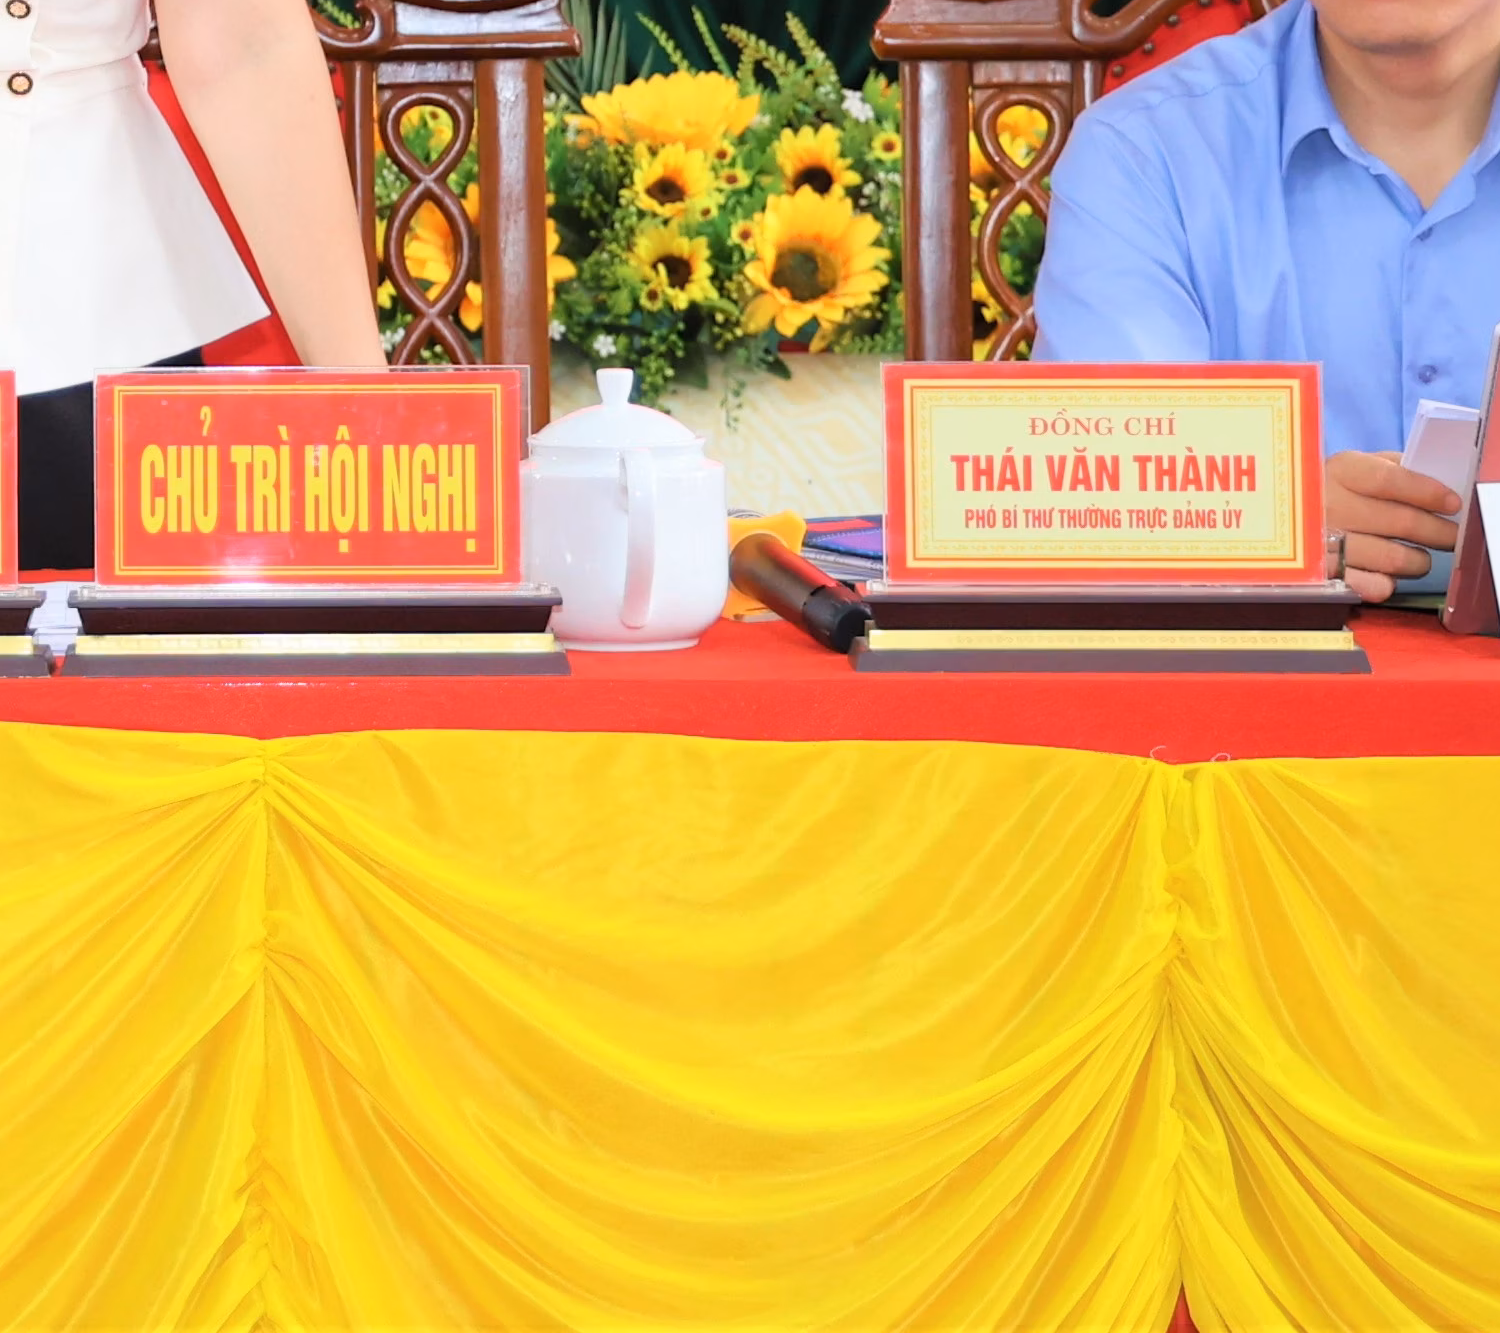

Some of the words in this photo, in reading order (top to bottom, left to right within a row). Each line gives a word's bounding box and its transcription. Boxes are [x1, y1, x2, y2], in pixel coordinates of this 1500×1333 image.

[1029, 409, 1114, 435] ĐỒNG
[1124, 413, 1176, 435] CHÍ
[141, 405, 217, 533] CHỦ
[231, 425, 290, 532] TRÌ
[305, 425, 368, 553] HỘI
[383, 443, 475, 552] NGHỊ
[951, 447, 1032, 491] THÁI
[1045, 446, 1119, 491] VĂN
[1133, 446, 1256, 491] THÀNH
[965, 504, 996, 528] PHÓ
[1003, 505, 1017, 528] BÍ
[1025, 507, 1055, 528] THƯ
[1059, 504, 1121, 528] THƯỜNG
[1127, 506, 1166, 533] TRỰC
[1173, 501, 1217, 529] ĐẢNG
[1222, 501, 1242, 528] ỦY
